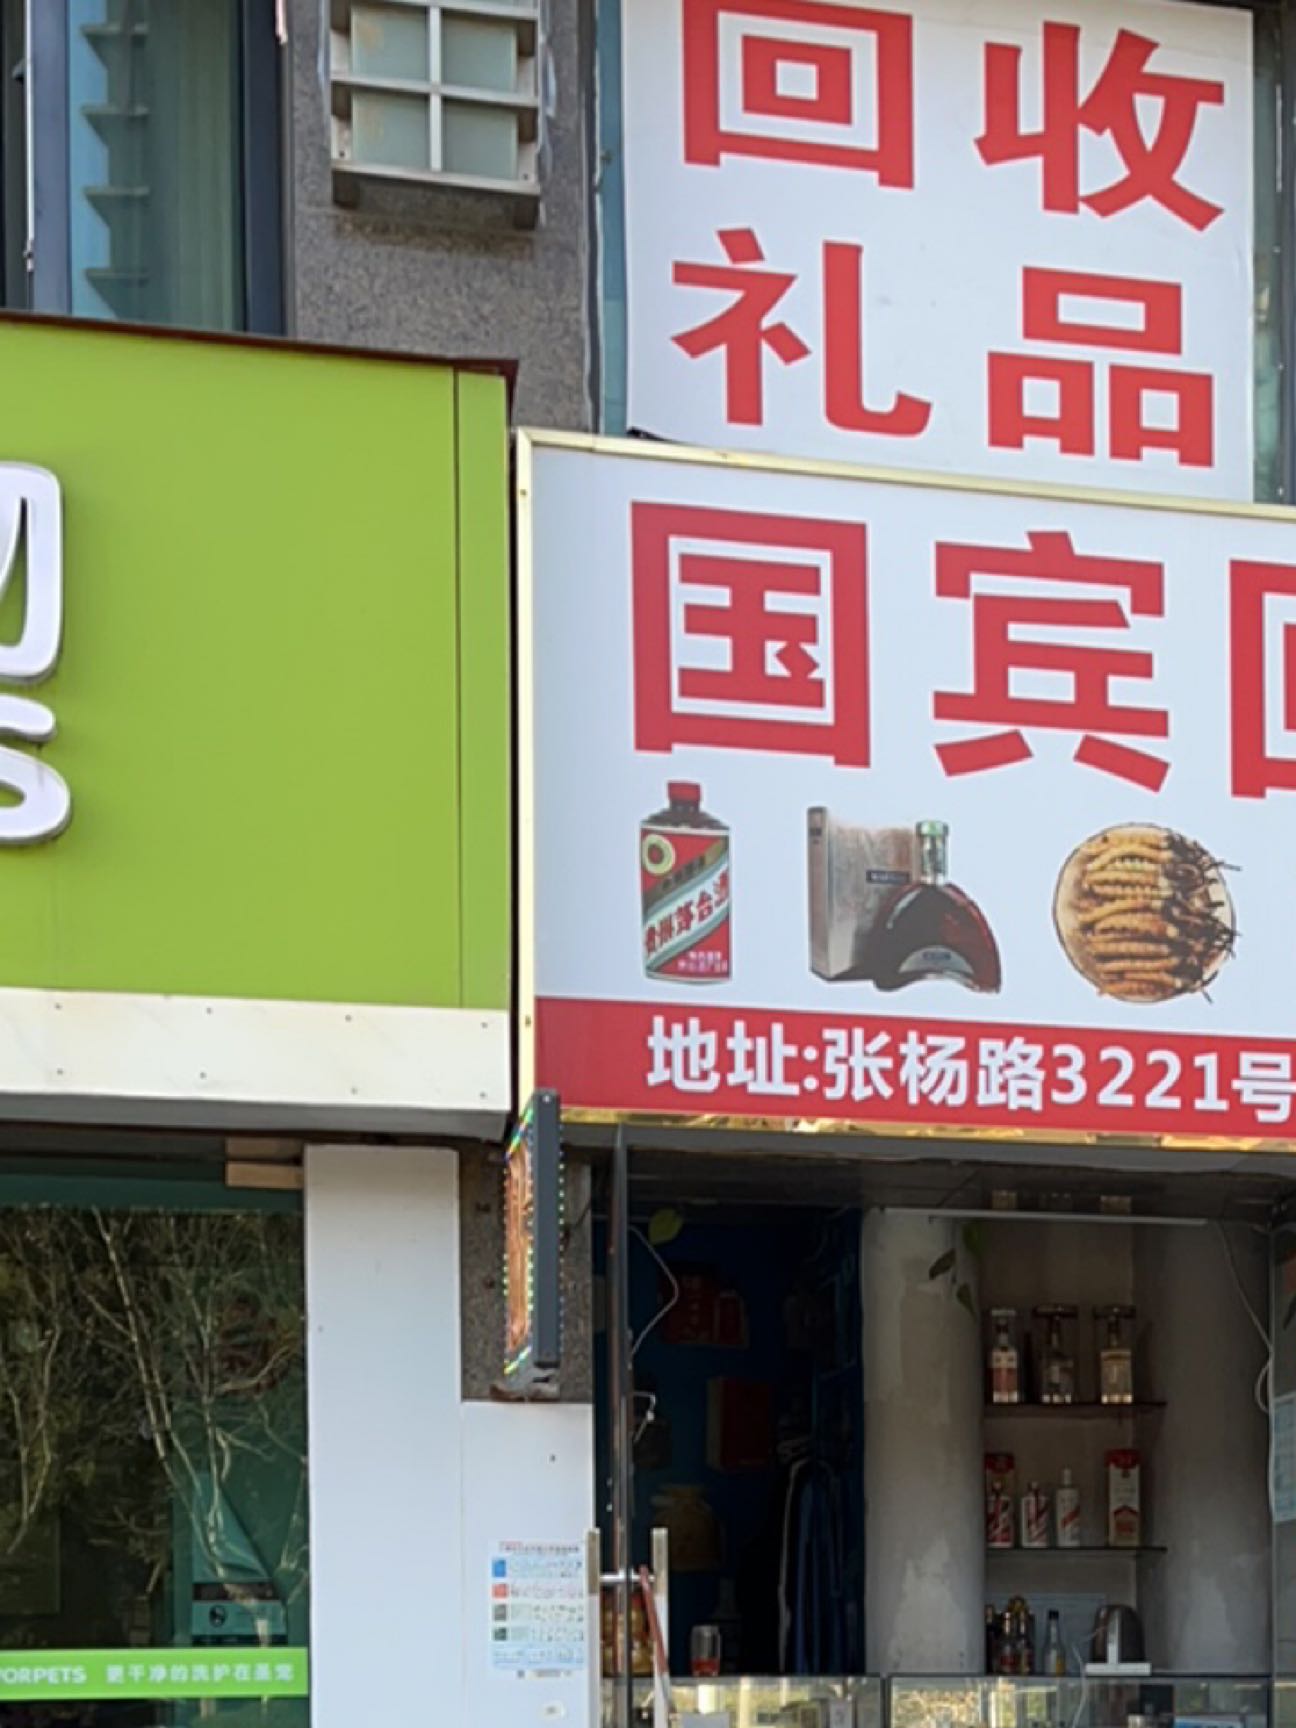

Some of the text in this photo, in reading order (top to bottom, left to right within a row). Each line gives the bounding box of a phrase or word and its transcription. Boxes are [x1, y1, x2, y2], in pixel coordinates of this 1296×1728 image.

[682, 0, 1225, 232] 回收
[671, 228, 1214, 468] 礼品
[0, 1666, 87, 1684] ORPETS
